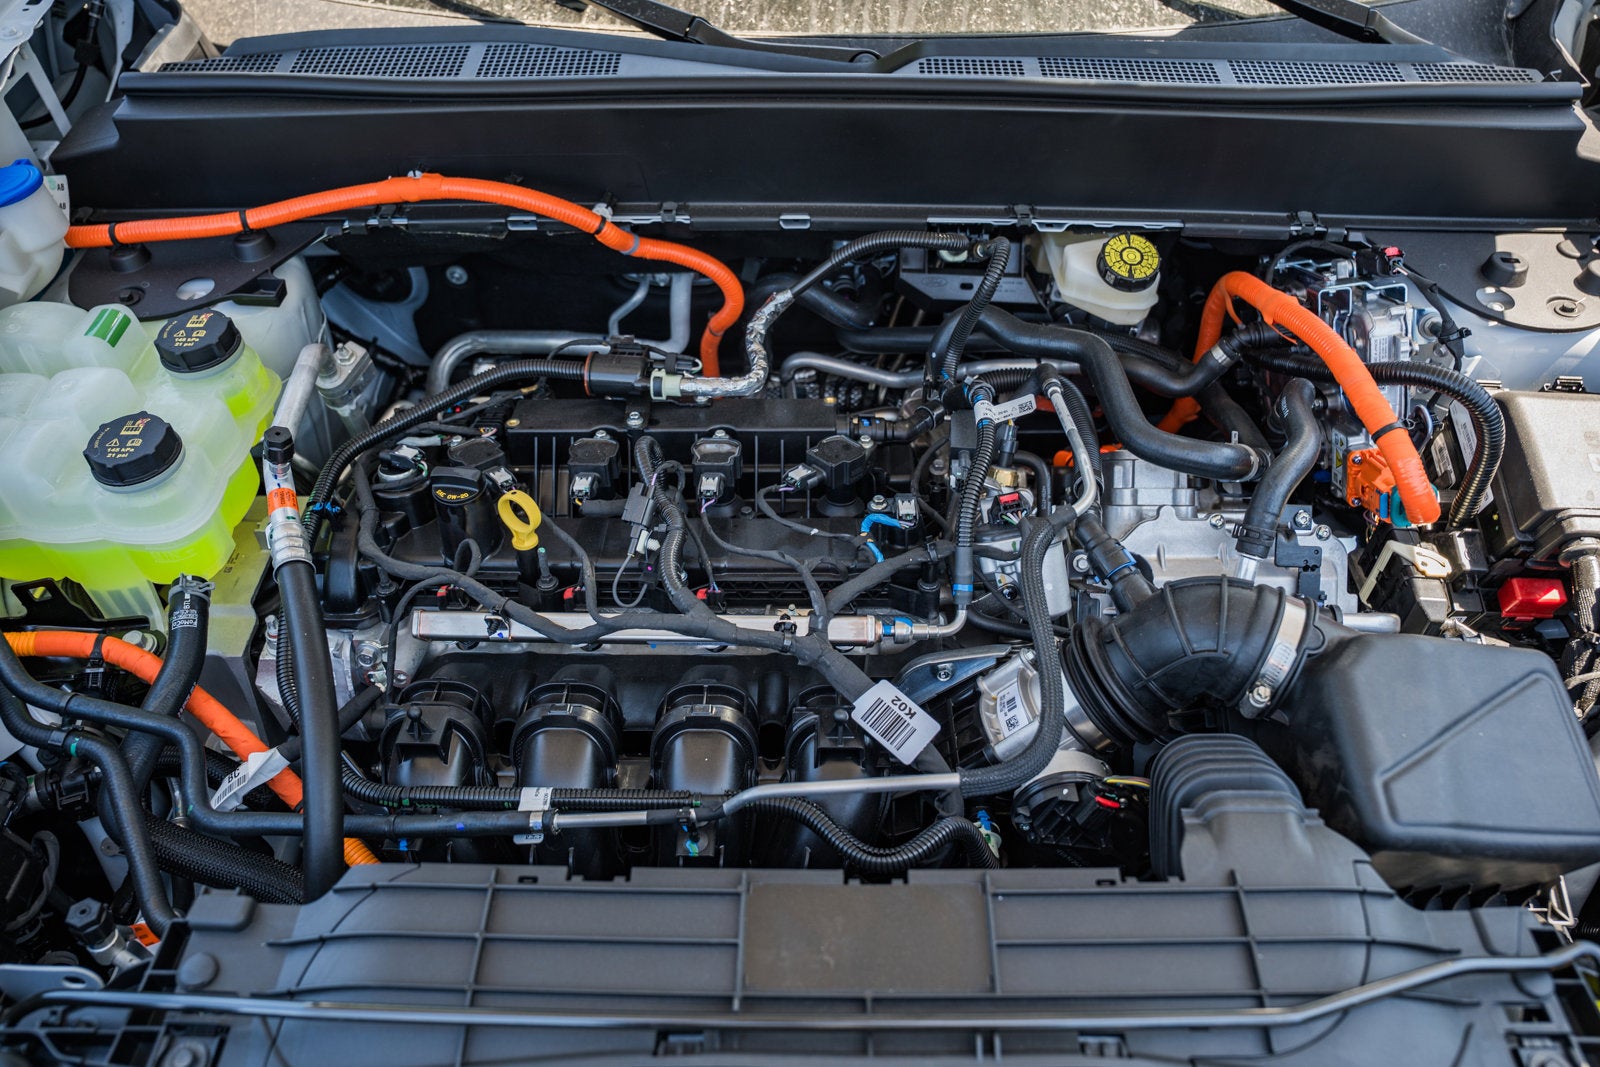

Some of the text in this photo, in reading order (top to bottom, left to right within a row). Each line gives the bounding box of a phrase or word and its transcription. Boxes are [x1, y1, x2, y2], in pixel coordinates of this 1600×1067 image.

[447, 492, 469, 500] 0W-20
[891, 695, 917, 720] K02
[227, 768, 241, 783] BC
